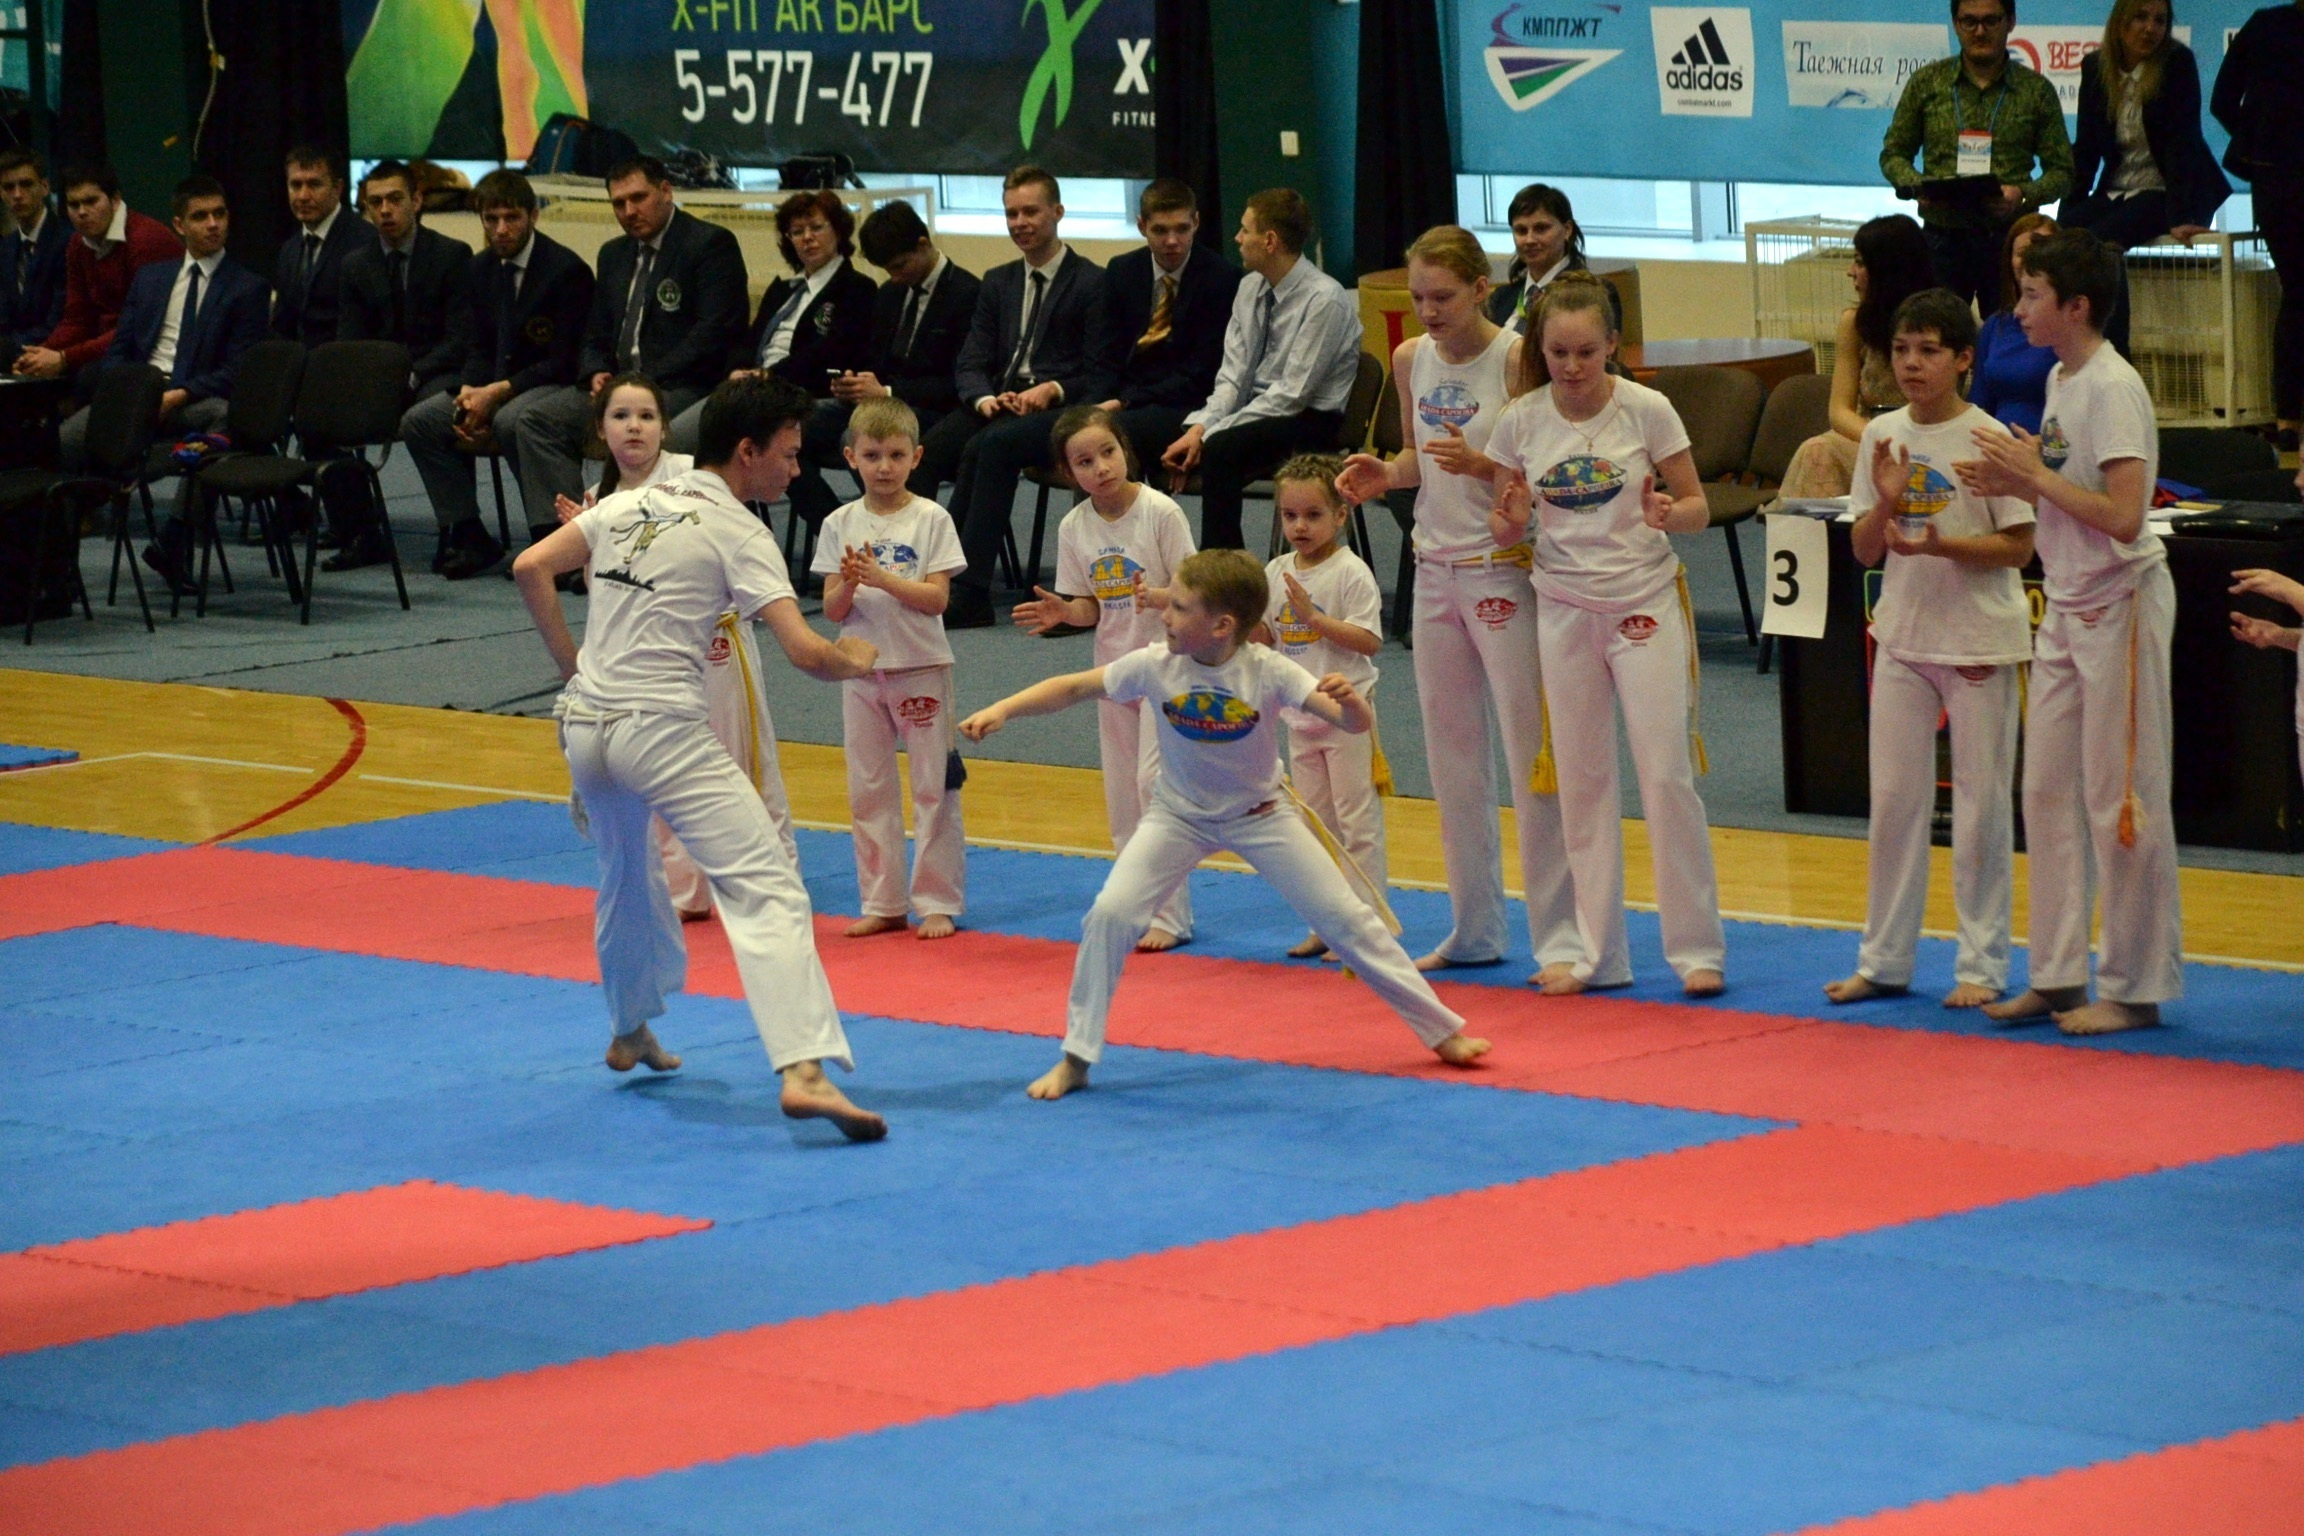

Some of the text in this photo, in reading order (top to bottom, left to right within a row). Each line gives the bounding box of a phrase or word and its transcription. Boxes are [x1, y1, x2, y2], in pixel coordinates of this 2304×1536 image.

[1523, 16, 1602, 38] КМППЖТ
[1793, 40, 1884, 75] Таежная
[674, 49, 933, 128] 5-577-477
[1666, 64, 1743, 91] adidas
[1772, 549, 1799, 606] 3
